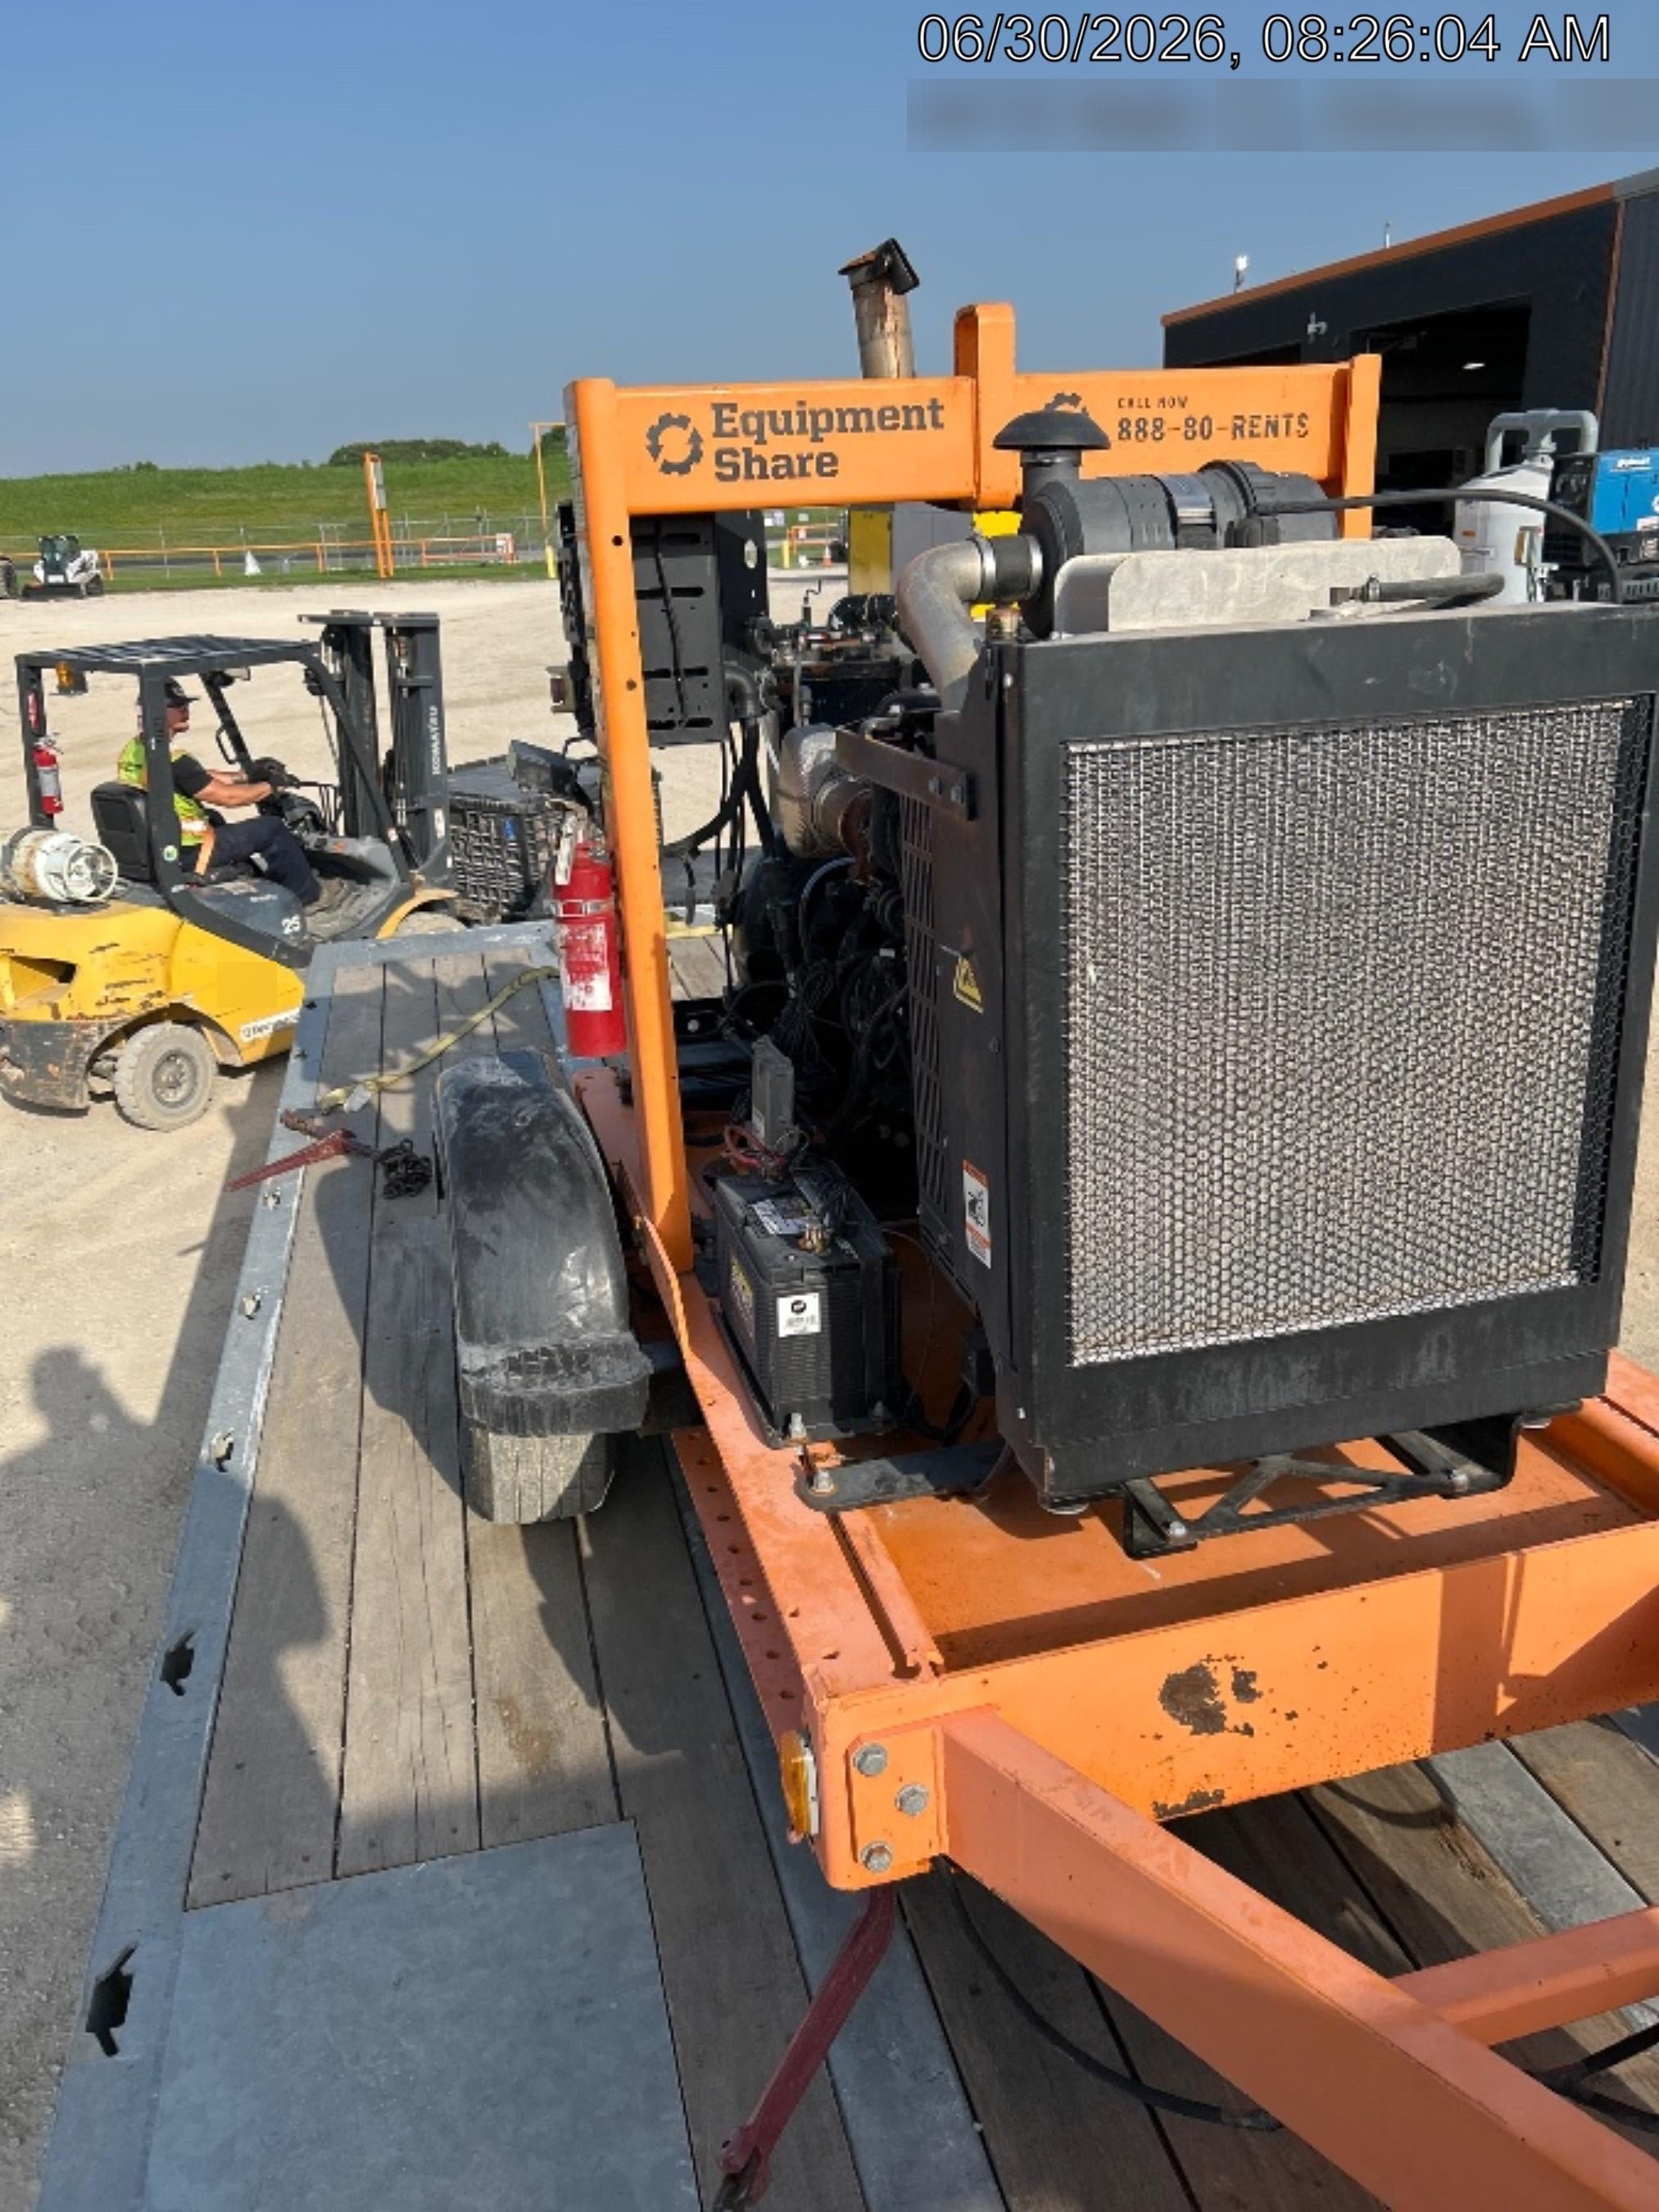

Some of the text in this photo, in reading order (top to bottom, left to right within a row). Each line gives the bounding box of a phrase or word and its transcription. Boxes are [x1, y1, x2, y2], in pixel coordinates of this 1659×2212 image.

[711, 398, 945, 445] Equipment
[1117, 413, 1309, 442] 888-80-RENTS
[714, 447, 839, 483] Share
